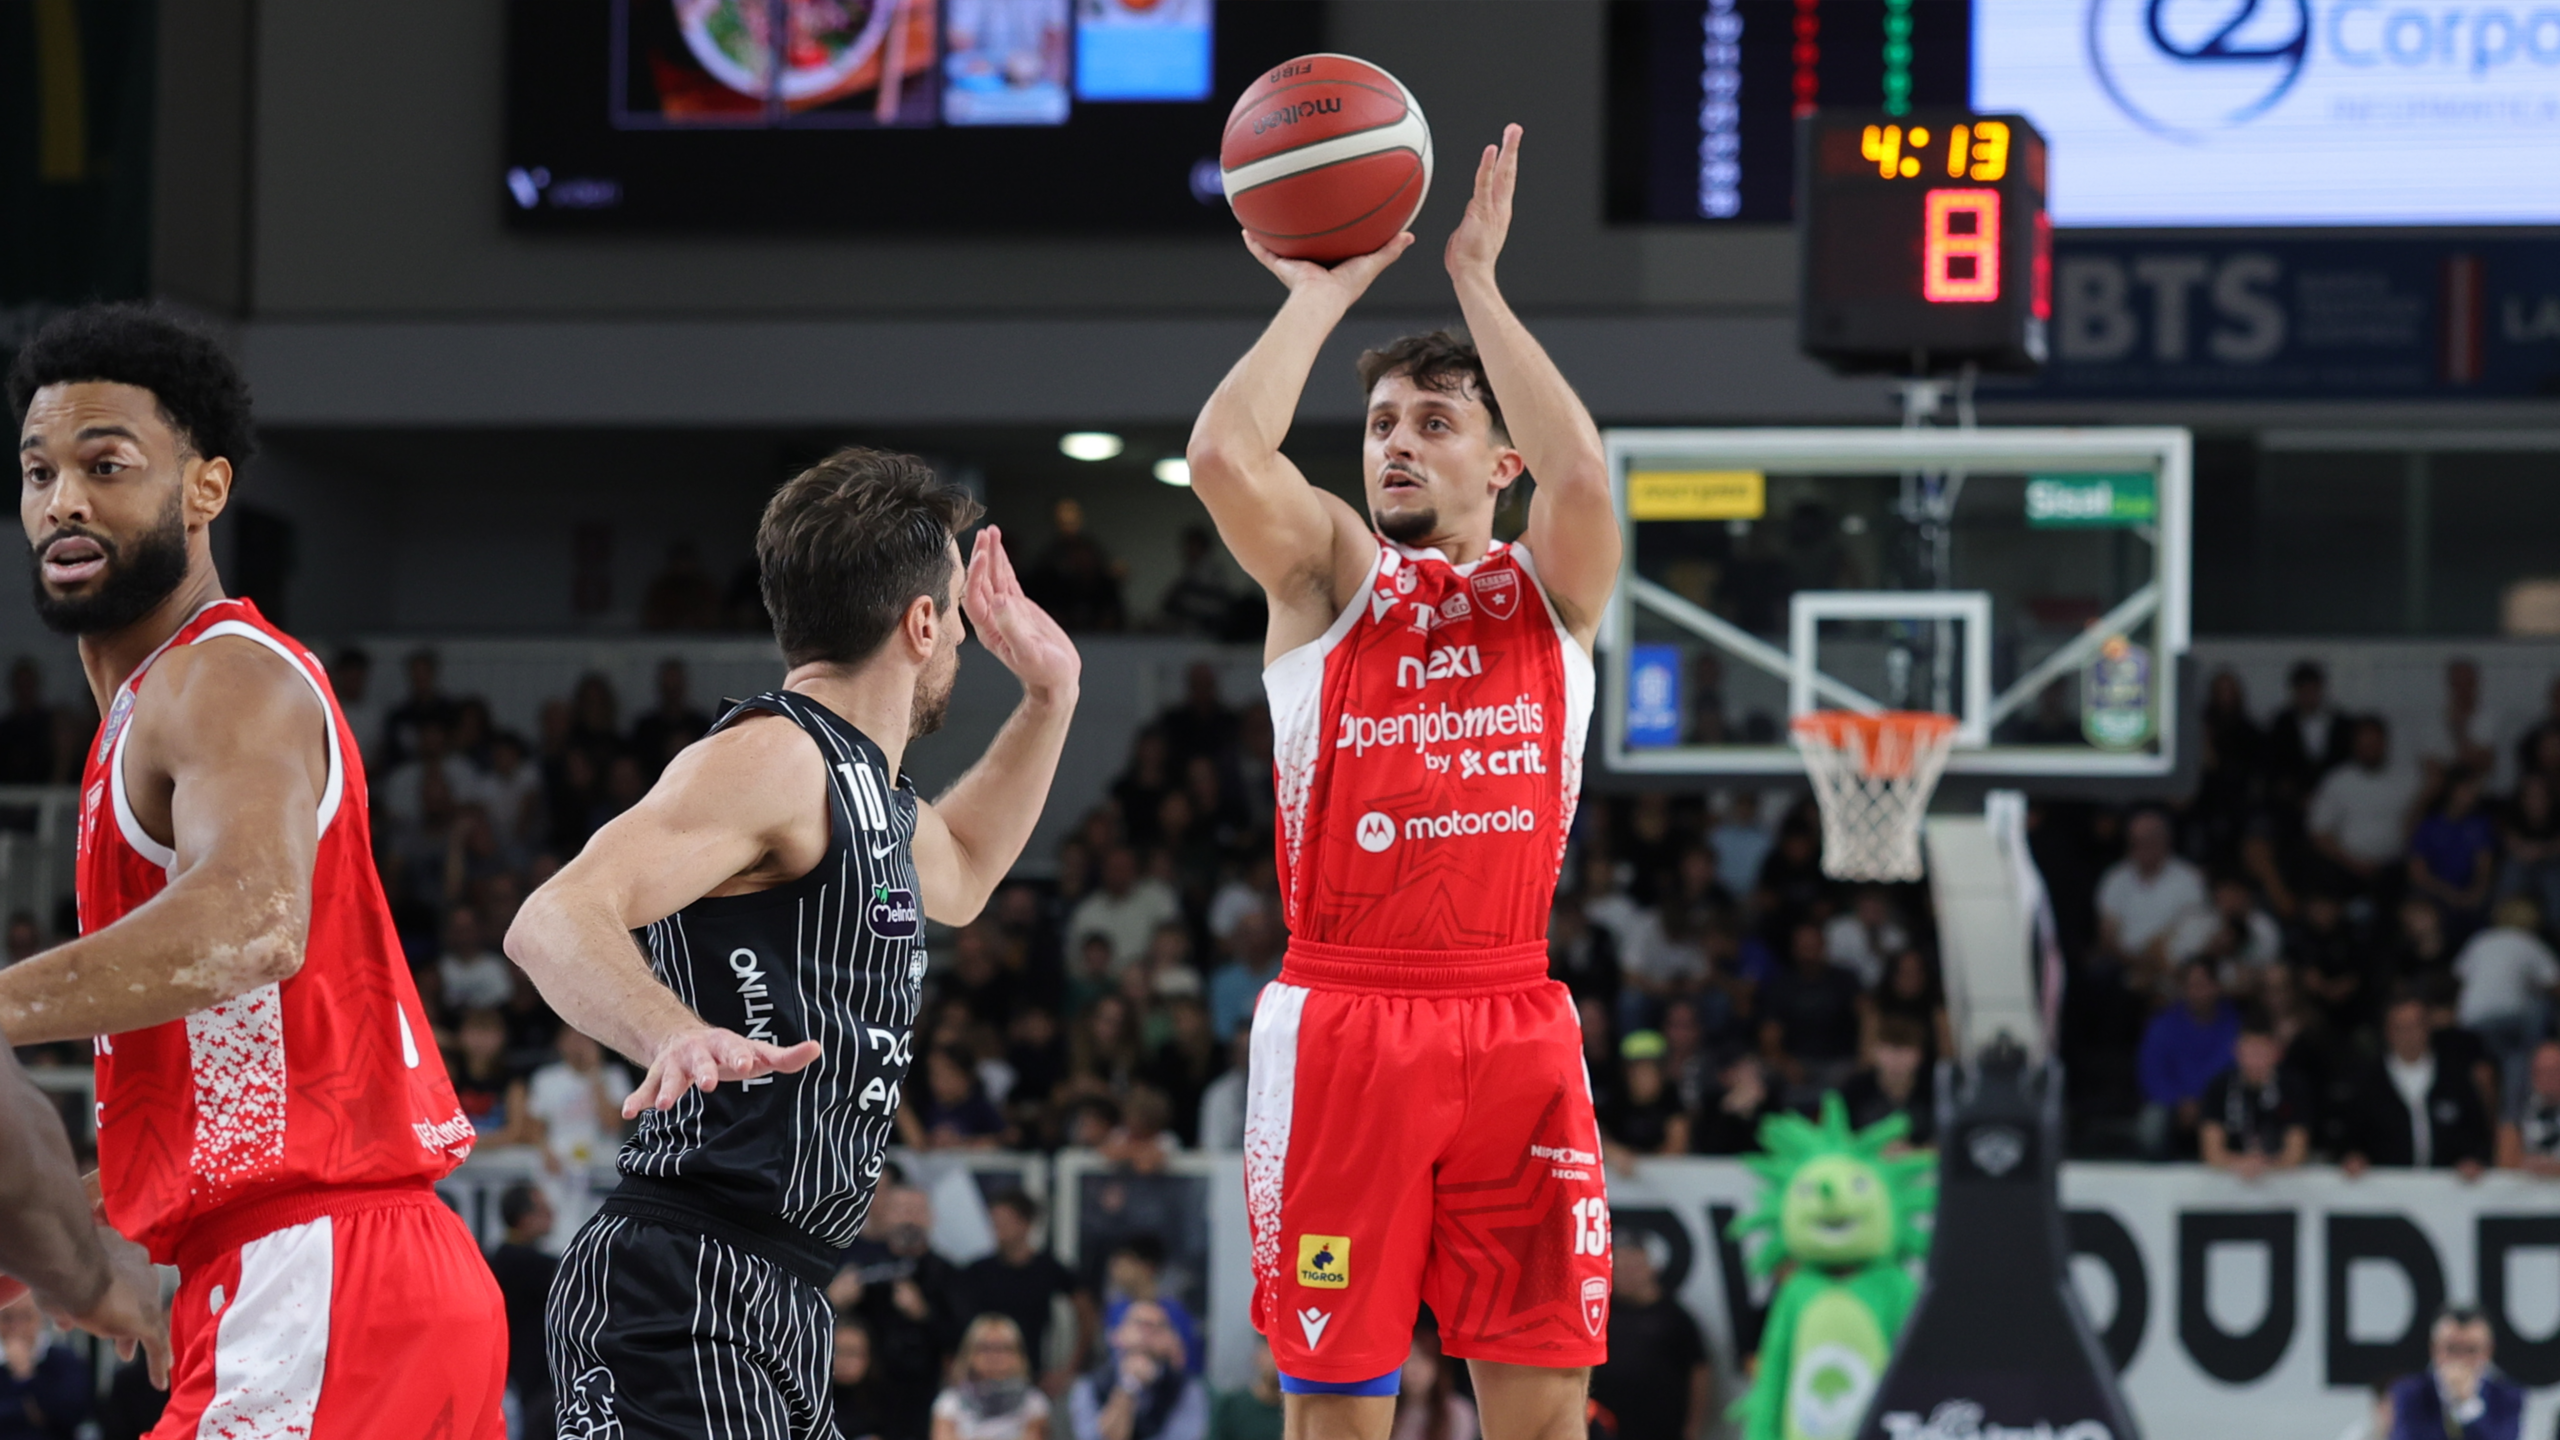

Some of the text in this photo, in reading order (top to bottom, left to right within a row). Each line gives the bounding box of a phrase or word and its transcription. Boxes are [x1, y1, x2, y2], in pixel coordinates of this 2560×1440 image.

[1252, 97, 1342, 135] molten
[1861, 121, 2010, 181] 4:13
[1923, 187, 2000, 303] 8
[2058, 256, 2288, 362] BTS
[1397, 645, 1482, 689] nexi
[1425, 740, 1547, 776] by crit.
[837, 762, 888, 831] 10
[1405, 804, 1535, 840] motorola
[1571, 1197, 1606, 1257] 13
[1301, 1270, 1345, 1283] TIGROS
